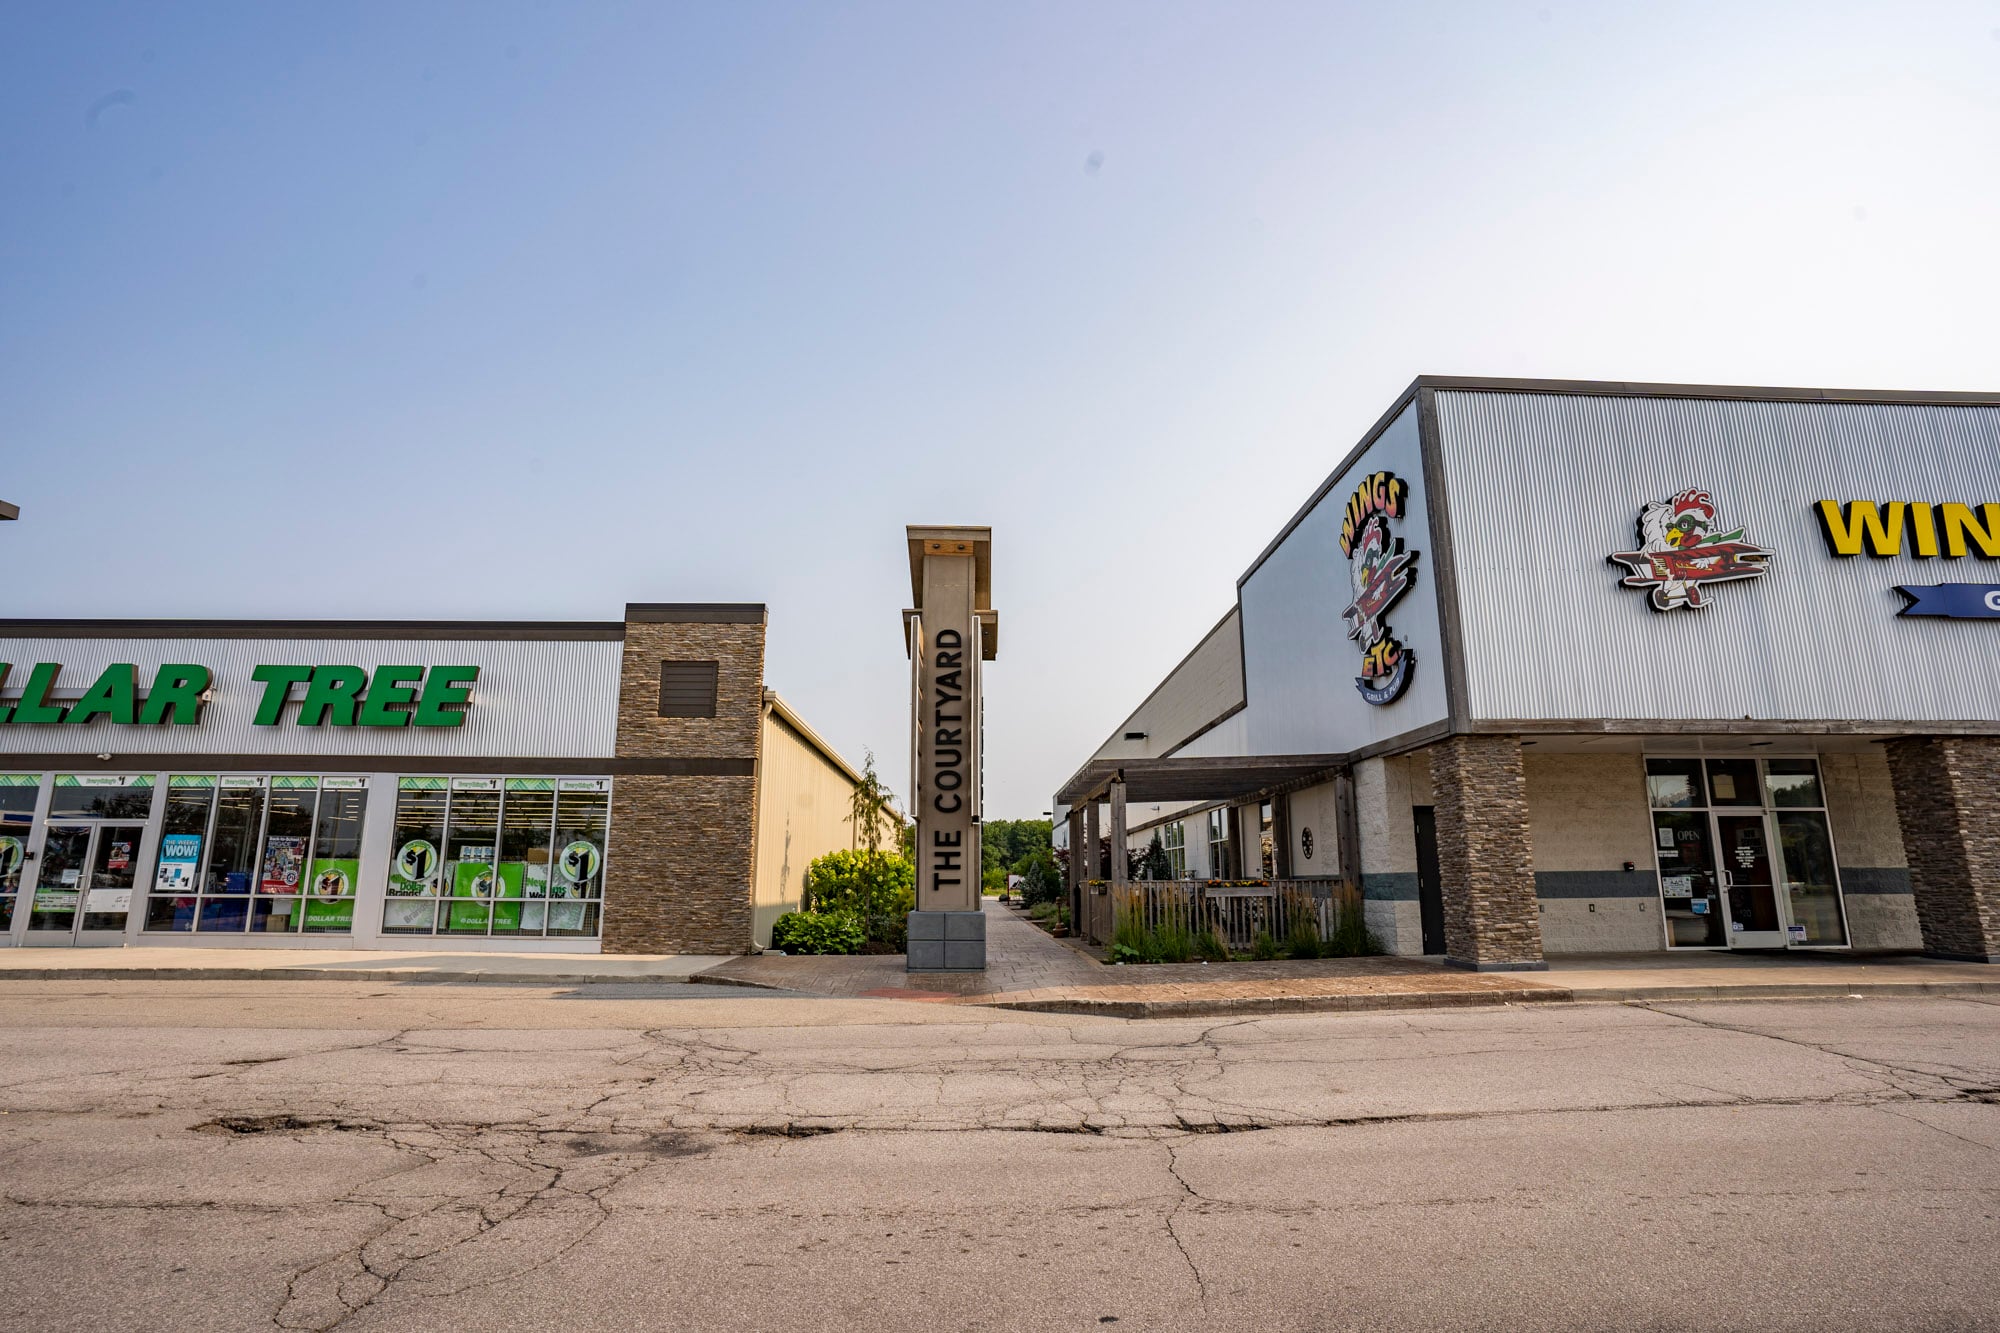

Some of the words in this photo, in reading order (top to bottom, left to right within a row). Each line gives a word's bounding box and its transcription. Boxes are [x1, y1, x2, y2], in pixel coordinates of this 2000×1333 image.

[1339, 471, 1403, 559] WINGS
[0, 662, 213, 725] LAR
[251, 664, 480, 727] TREE
[1366, 691, 1383, 701] GRILL
[1389, 677, 1400, 696] PUB
[934, 628, 962, 814] COURTYARD
[1678, 830, 1700, 840] OPEN
[165, 845, 198, 857] WOW!
[405, 849, 428, 880] $1
[567, 850, 590, 882] $1
[934, 829, 961, 891] THE
[400, 881, 426, 892] Dollar
[540, 885, 567, 894] Itms
